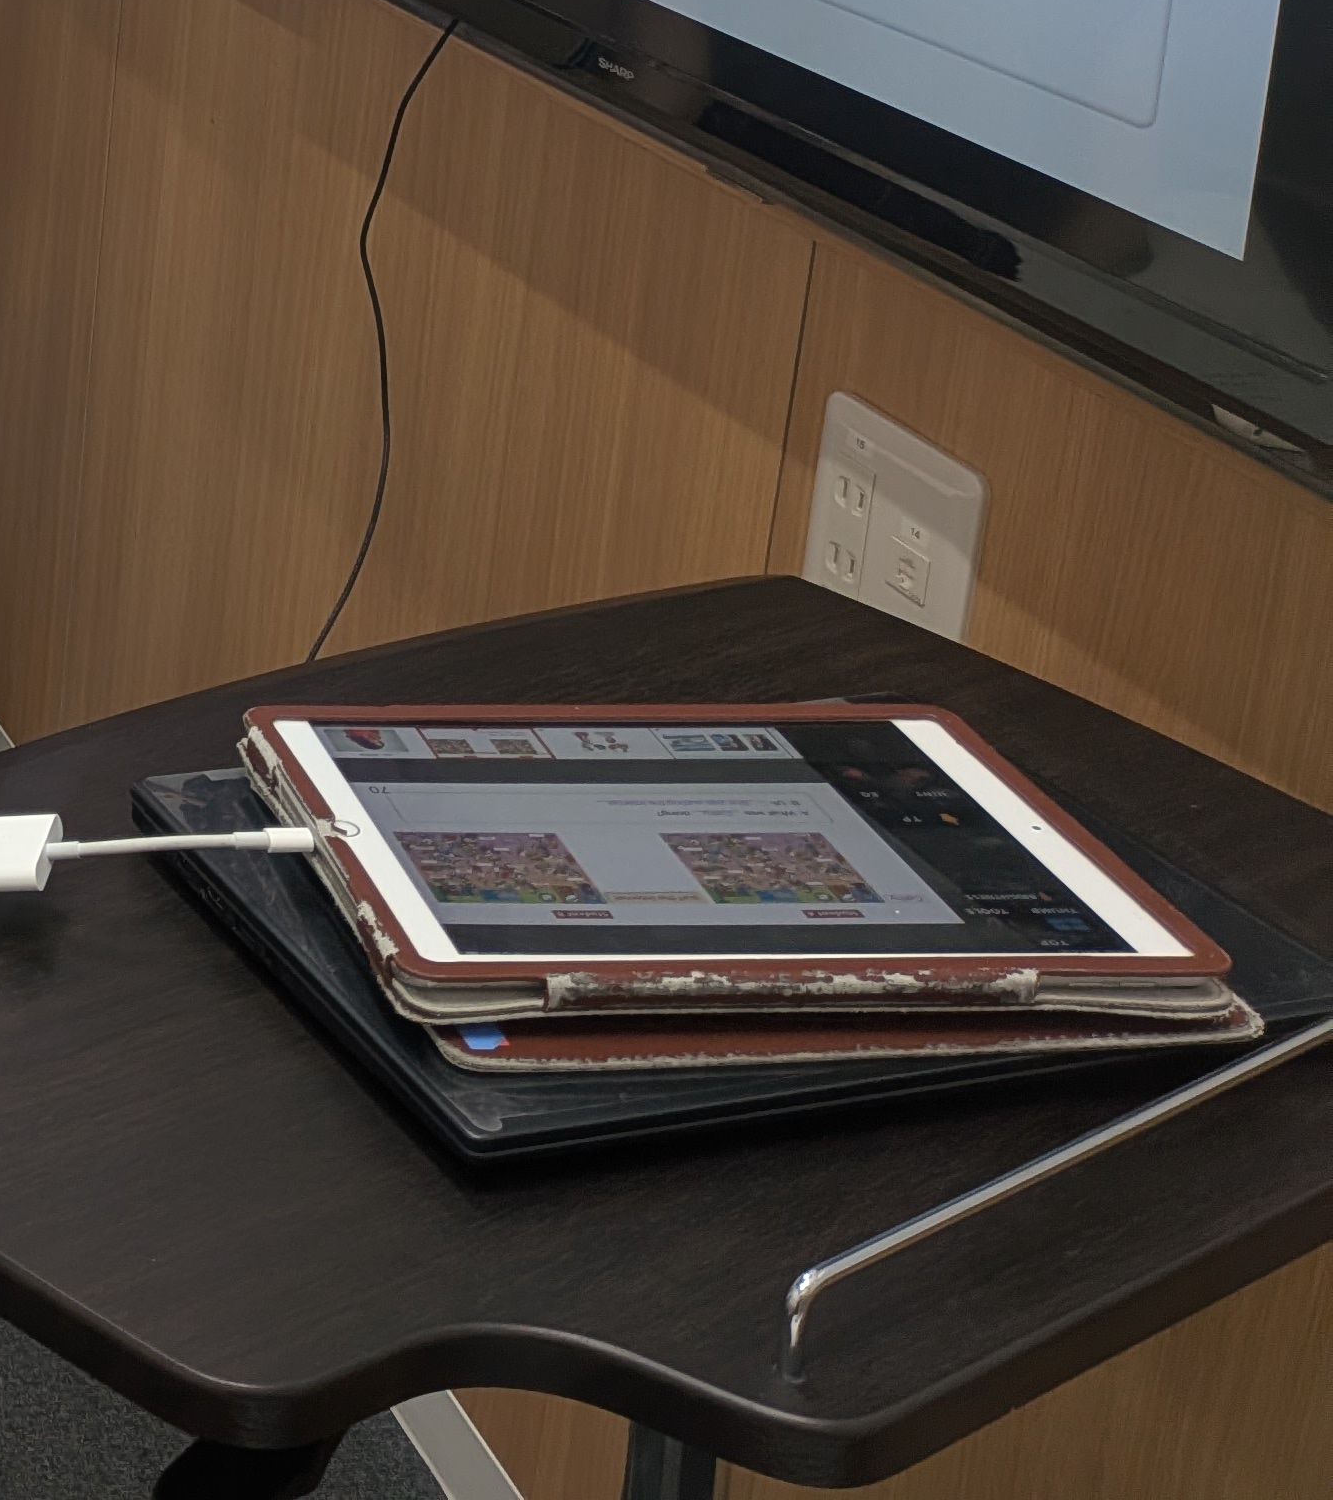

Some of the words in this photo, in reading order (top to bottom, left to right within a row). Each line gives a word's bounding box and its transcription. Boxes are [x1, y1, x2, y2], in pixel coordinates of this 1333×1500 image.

[598, 56, 635, 80] SHARP
[856, 438, 865, 450] 15
[910, 527, 920, 540] 14
[368, 786, 391, 794] 70
